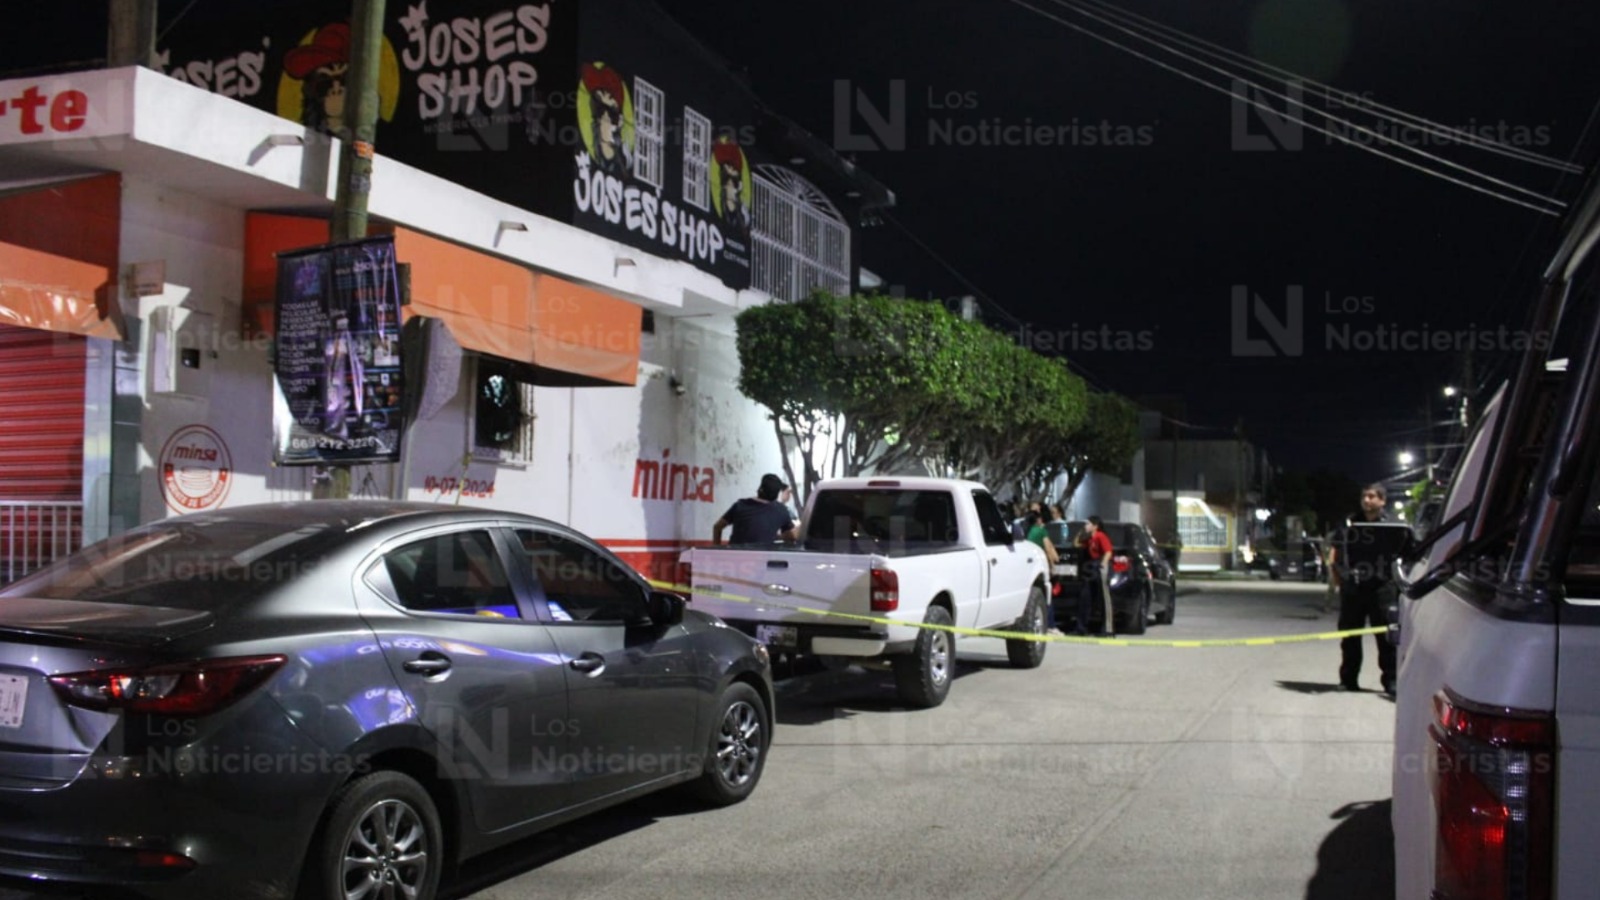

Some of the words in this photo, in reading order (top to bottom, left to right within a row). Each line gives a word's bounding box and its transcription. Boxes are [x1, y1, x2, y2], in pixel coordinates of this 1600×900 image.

[0, 86, 88, 135] te
[416, 61, 537, 120] SHOP
[659, 201, 723, 265] SHOP
[174, 443, 218, 461] minsa
[632, 447, 716, 503] minsa
